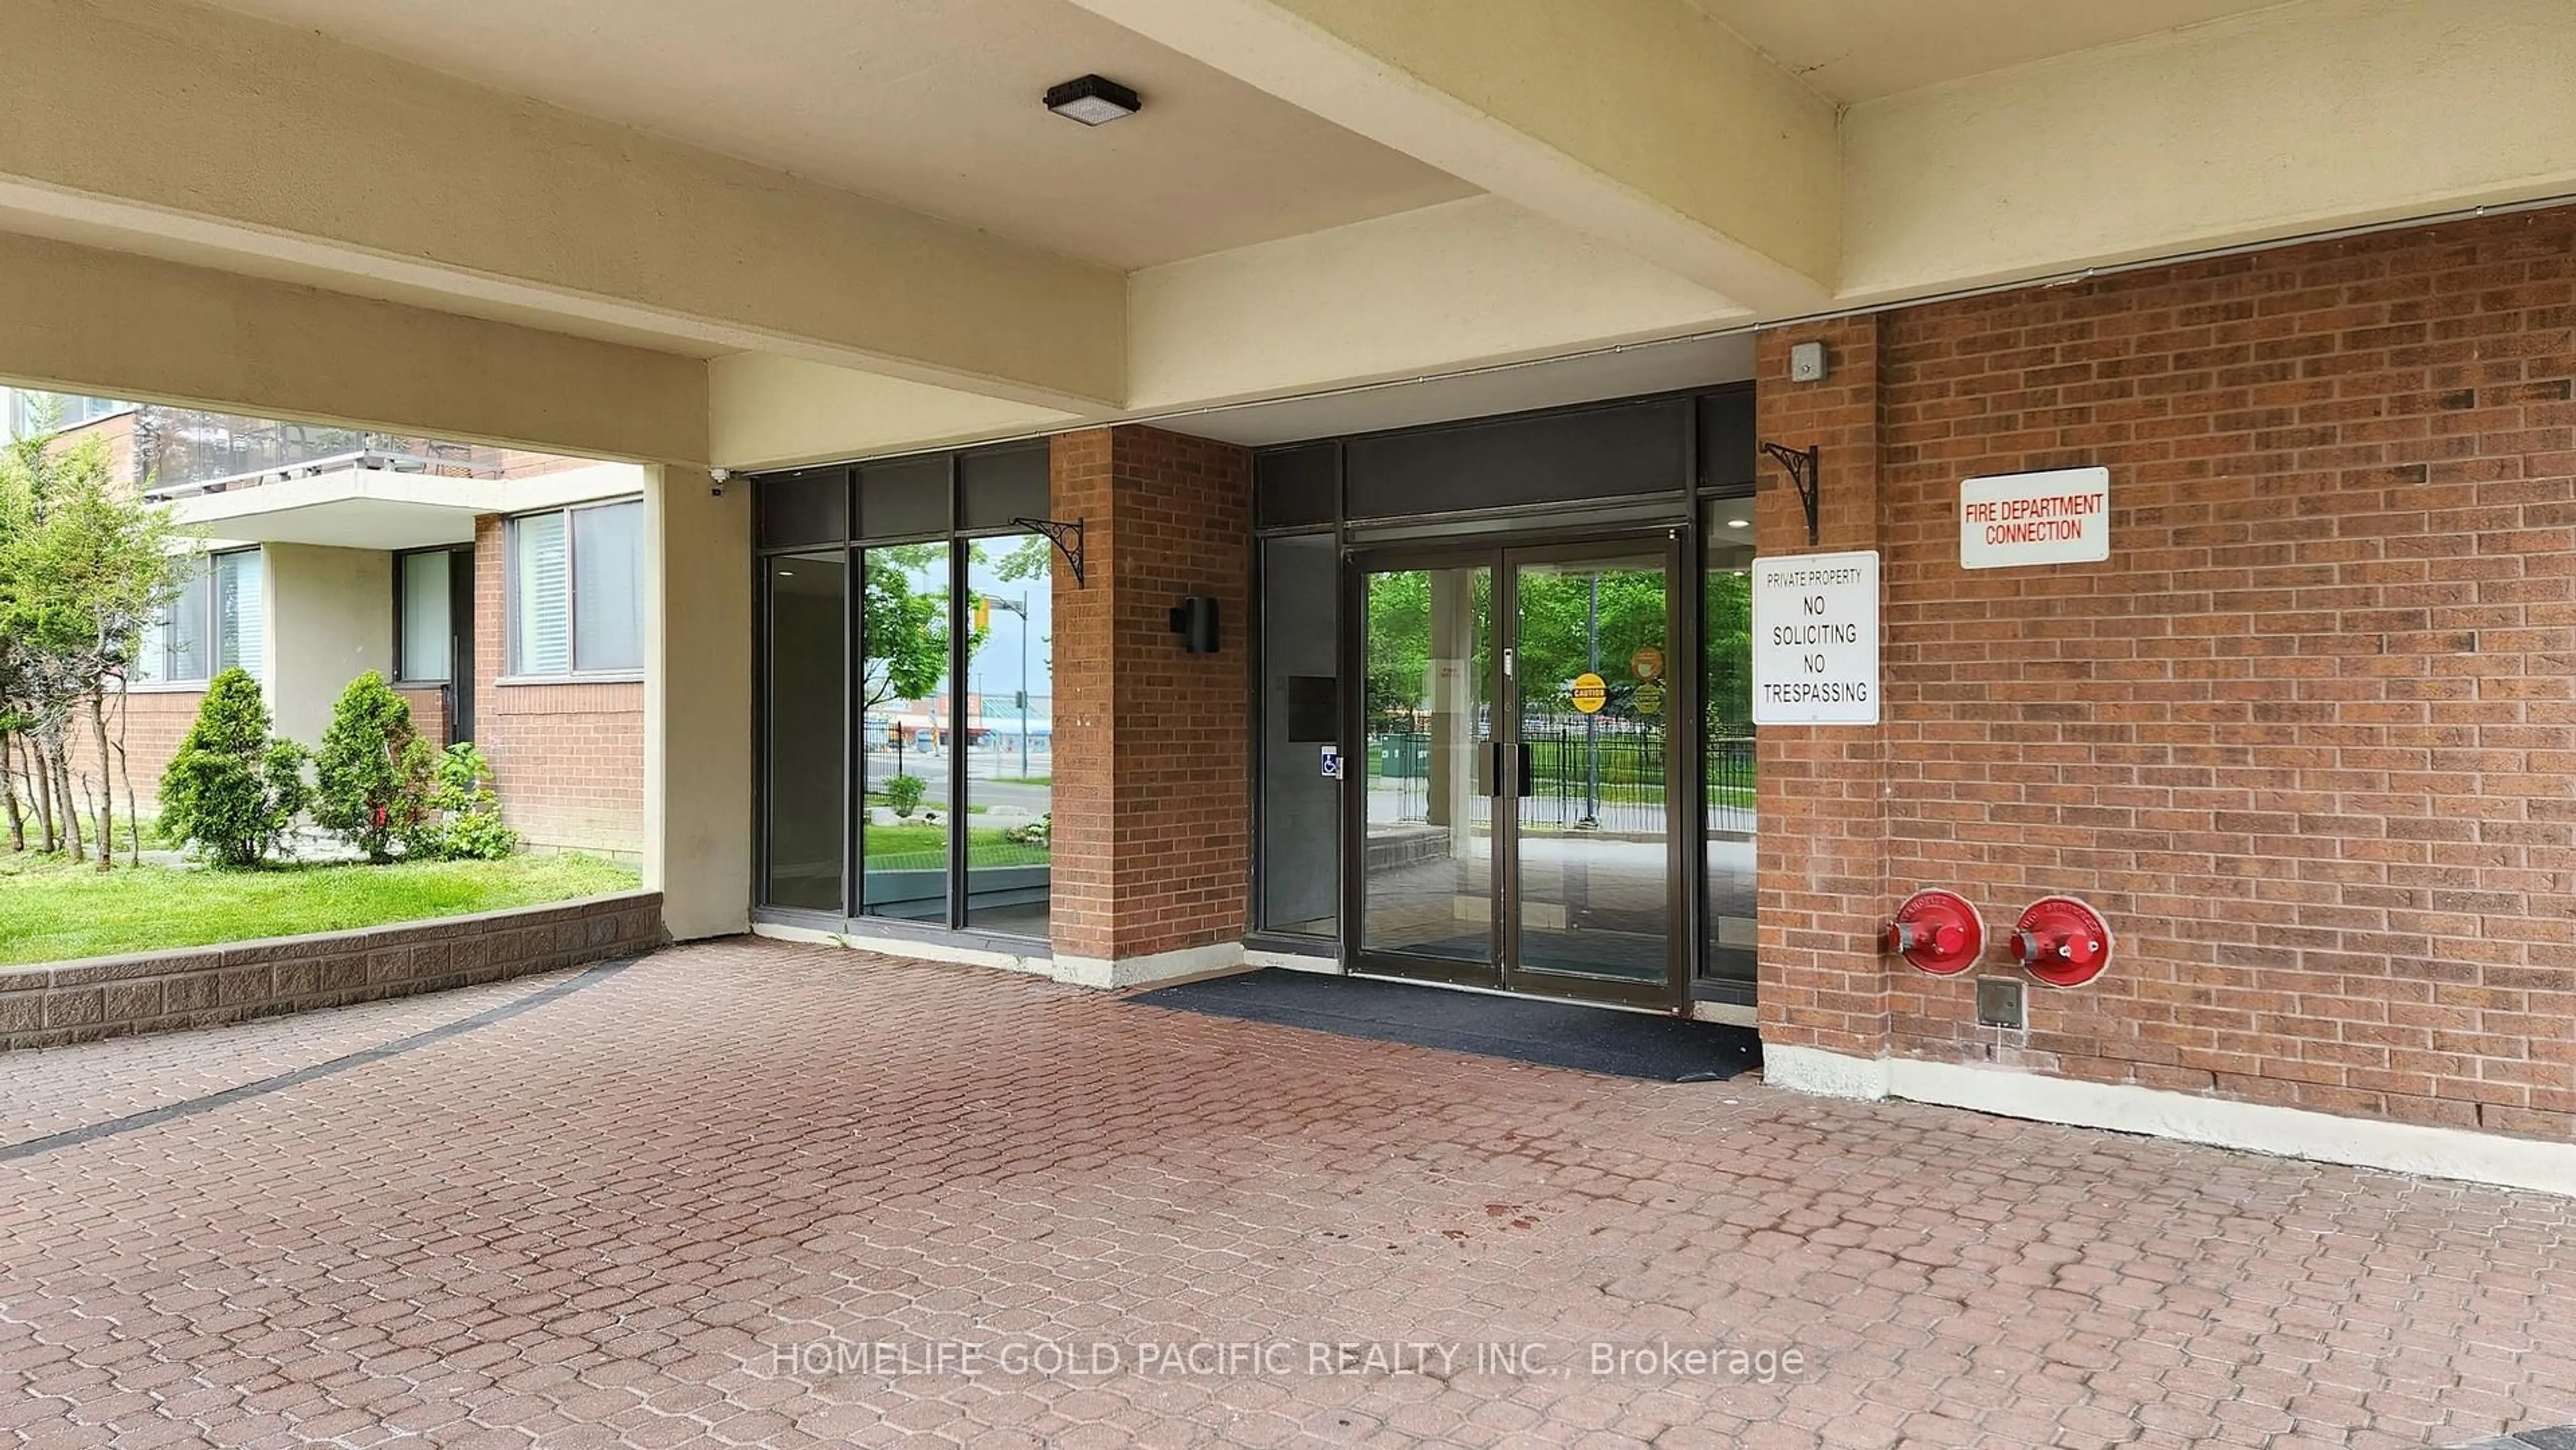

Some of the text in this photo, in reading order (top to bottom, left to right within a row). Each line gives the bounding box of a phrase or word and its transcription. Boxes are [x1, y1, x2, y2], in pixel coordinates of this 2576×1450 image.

[1966, 493, 2104, 524] FIRE DEPARTMENT
[1985, 519, 2082, 545] CONNECTION
[1767, 568, 1862, 588] PRIVATE PROPERTY
[1803, 595, 1825, 616] NO
[1773, 623, 1857, 646] SOLICITING
[1804, 654, 1825, 673] NO
[1763, 682, 1868, 703] TRESPASSING
